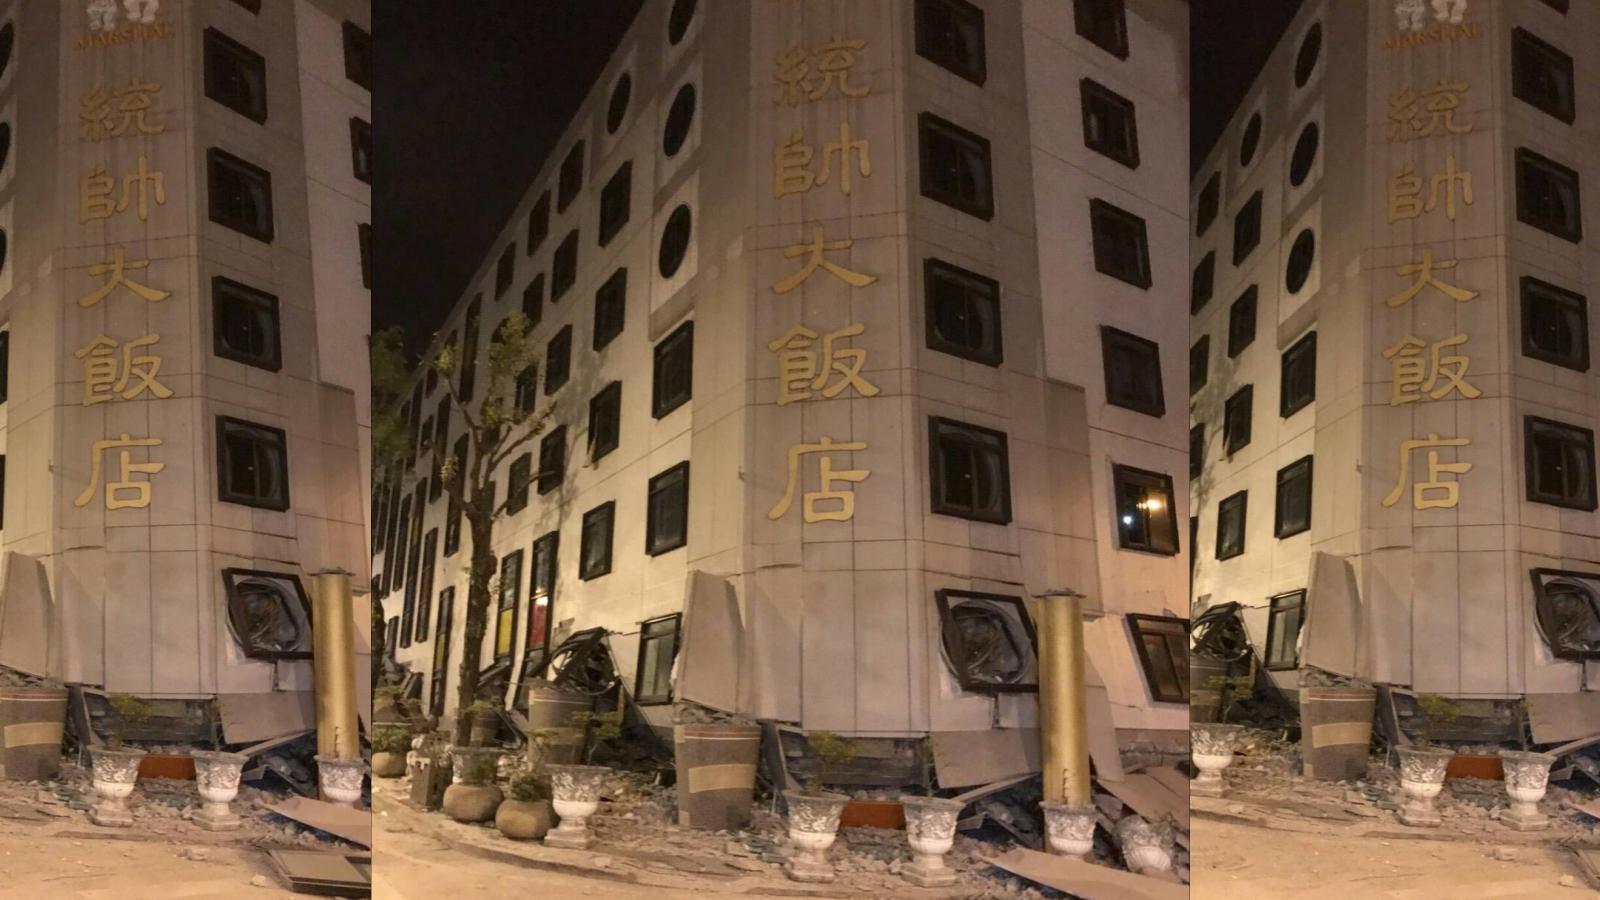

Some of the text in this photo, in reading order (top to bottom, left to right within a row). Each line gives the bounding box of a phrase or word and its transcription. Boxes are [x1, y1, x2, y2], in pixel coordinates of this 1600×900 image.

[74, 81, 174, 510] 統帥大飯店
[768, 37, 881, 524] 統帥大飯店
[1381, 81, 1481, 510] 統帥大飯店
